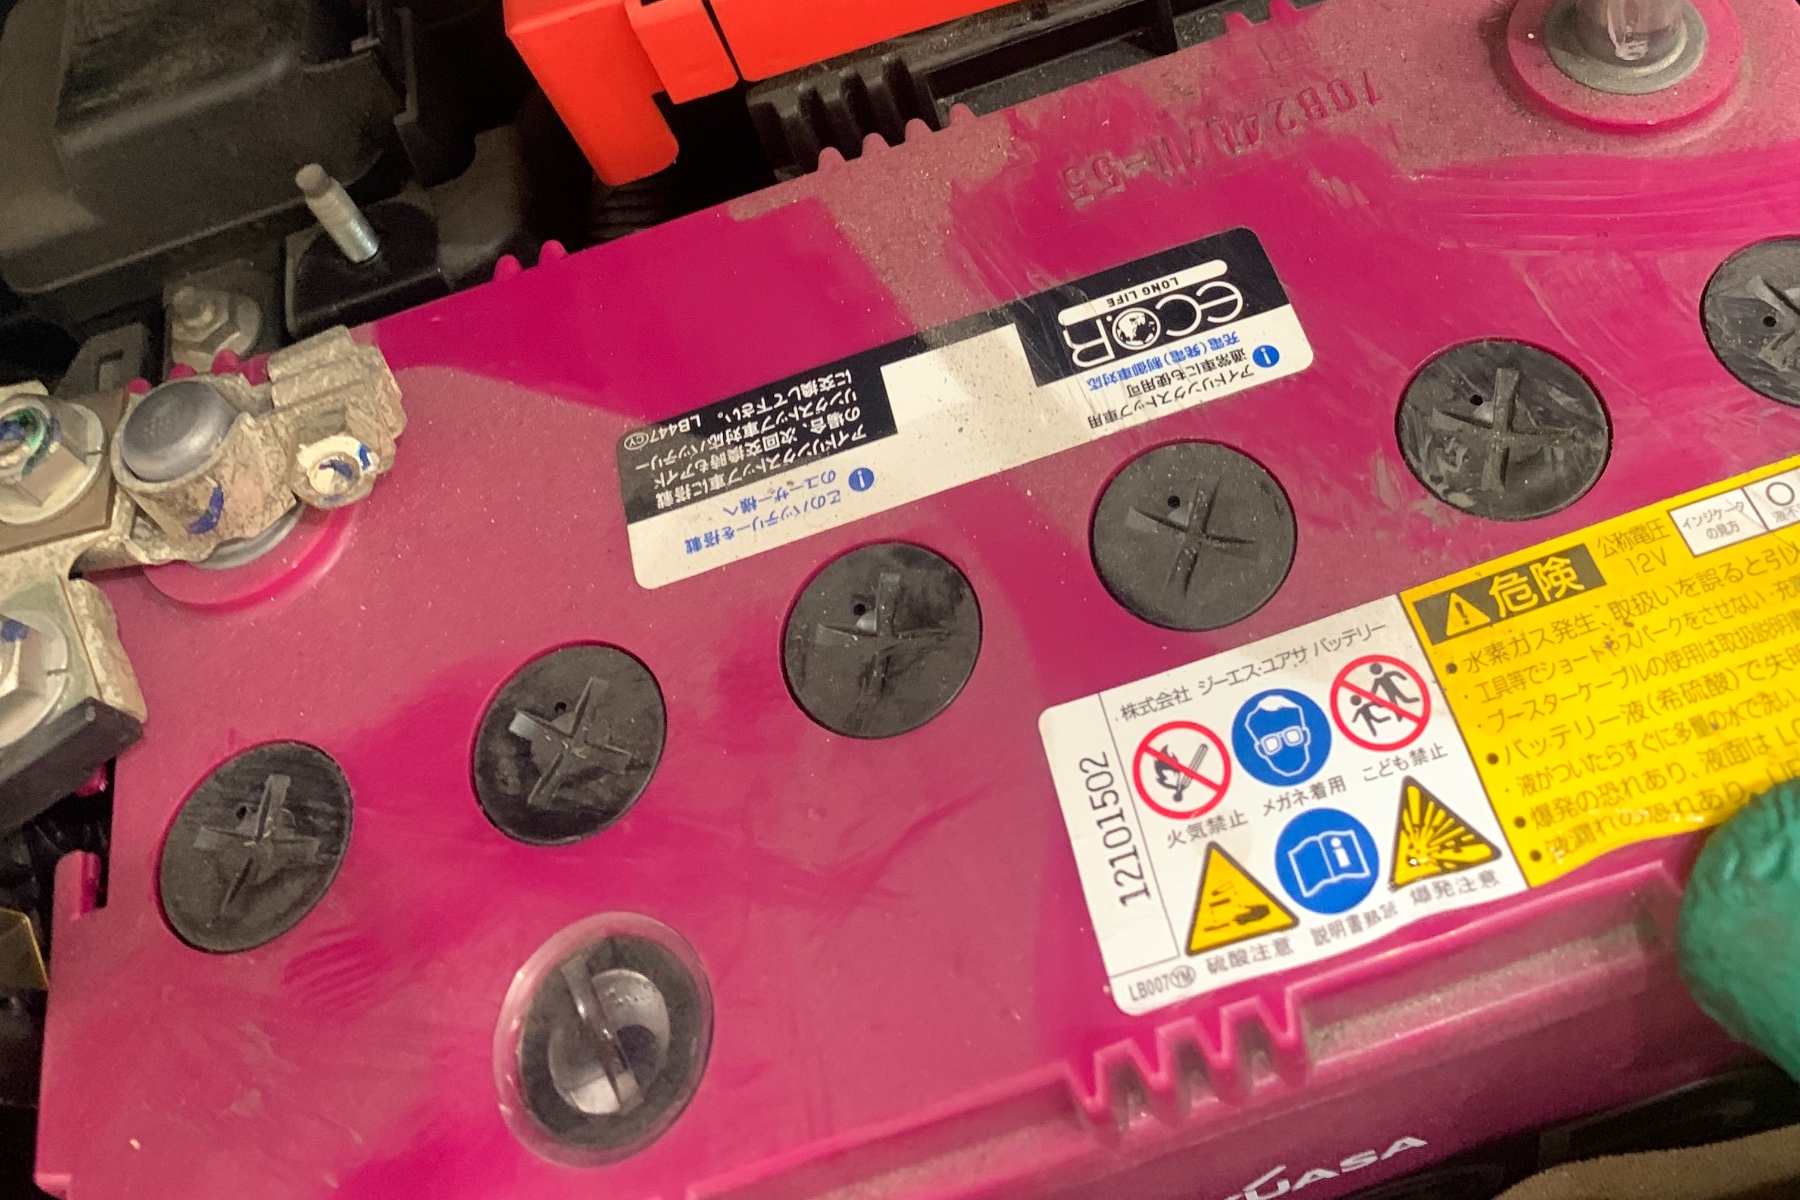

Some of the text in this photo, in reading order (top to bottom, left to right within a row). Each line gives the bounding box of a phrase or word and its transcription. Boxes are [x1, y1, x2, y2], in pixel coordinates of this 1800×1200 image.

[1106, 276, 1180, 309] LONG LIFE
[1126, 346, 1248, 399] 通常車にも使用可
[1086, 364, 1256, 430] アイドリングストップ車用
[635, 387, 858, 472] リングストップ車対応バッテリー
[653, 405, 862, 491] の場合、次回交換時もアイド
[655, 423, 868, 510] アイドリングストップ車に搭載
[722, 469, 837, 517] のユーザー様へ
[1681, 500, 1745, 531] インジケータ
[684, 489, 842, 555] このバッテリーを搭載
[1597, 518, 1671, 560] 公称電圧
[1705, 520, 1741, 541] の見方
[1624, 547, 1669, 577] 12V
[1488, 556, 1586, 617] 危険
[1119, 685, 1193, 722] 株式会社
[1313, 624, 1388, 658] バッテリー
[1361, 742, 1449, 784] こども禁止
[1261, 775, 1348, 818] メガネ着用
[1078, 750, 1151, 908] 12101502
[1166, 809, 1249, 849] 火気禁止
[1408, 869, 1502, 907] 爆発注意
[1205, 936, 1295, 976] 硫酸注意
[1224, 1135, 1428, 1200] UASA
